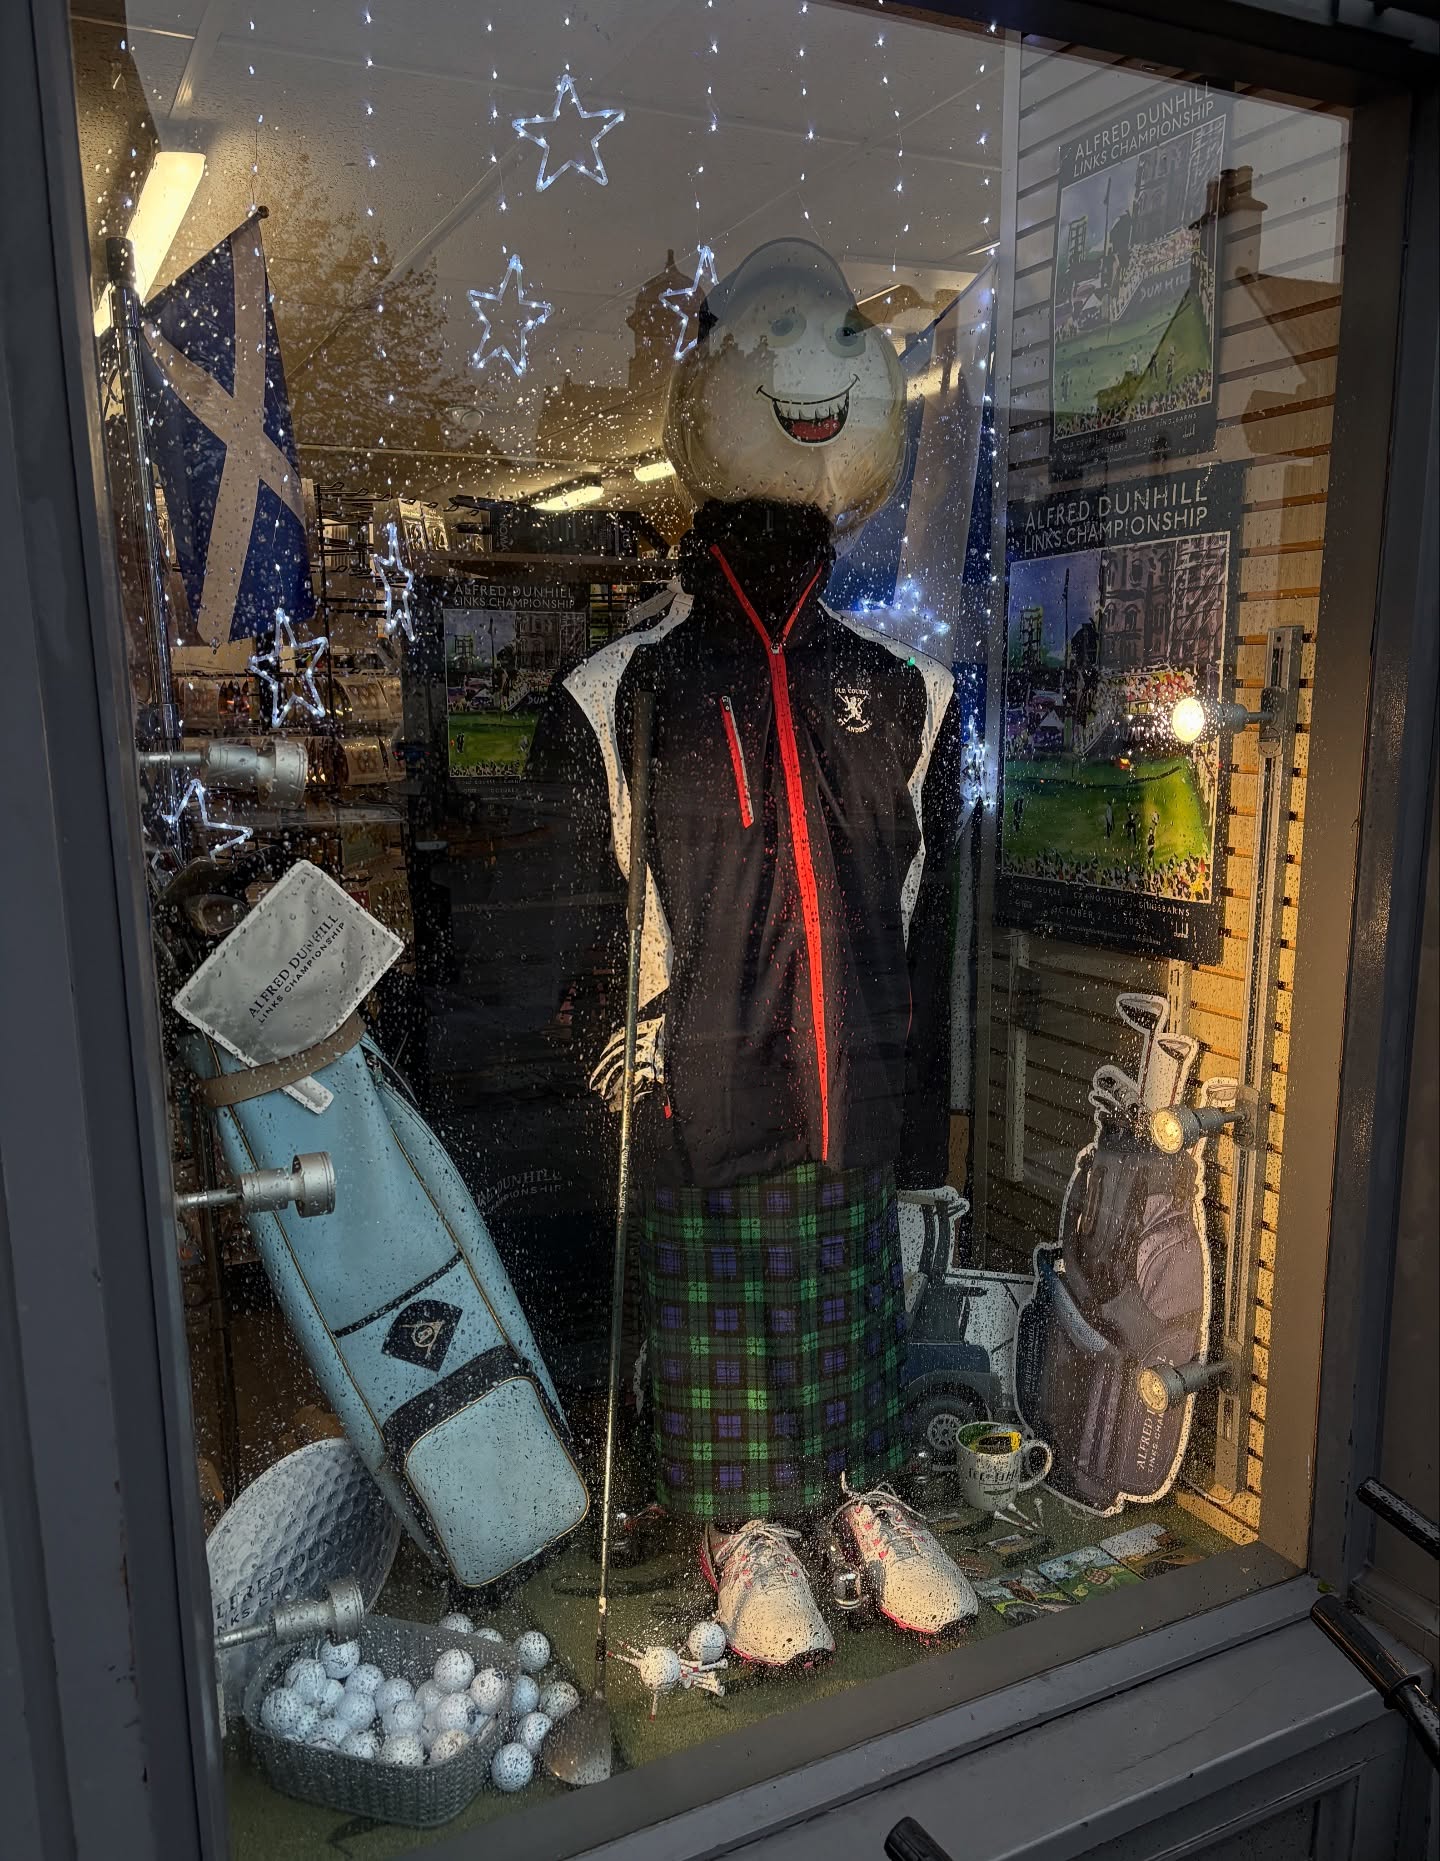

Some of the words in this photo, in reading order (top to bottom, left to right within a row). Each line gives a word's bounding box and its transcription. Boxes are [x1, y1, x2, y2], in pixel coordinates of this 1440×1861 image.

[1073, 150, 1107, 178] LINKS
[1110, 101, 1215, 159] CHAMPIONSHIP
[1075, 120, 1131, 161] ALFRED
[1137, 82, 1214, 131] DUNHILL
[1023, 529, 1062, 554] LINKS
[1066, 506, 1208, 546] CHAMPIONSHIP
[1024, 500, 1090, 533] ALFRED
[1098, 481, 1208, 517] DUNHILL
[454, 584, 507, 597] ALFRED
[512, 585, 572, 598] DUNHILL
[454, 597, 486, 607] LINKS
[489, 597, 575, 609] CHAMPIONSHIP
[1052, 905, 1093, 920] OCTOBER
[1123, 917, 1145, 928] 2025
[249, 969, 290, 1018] ALFRED
[288, 915, 339, 970] DUNHILL
[258, 995, 283, 1024] LINKS
[284, 922, 345, 993] CHAMPIONSHIP
[1137, 1418, 1153, 1470] ALFRED
[215, 1567, 284, 1620] LFRED
